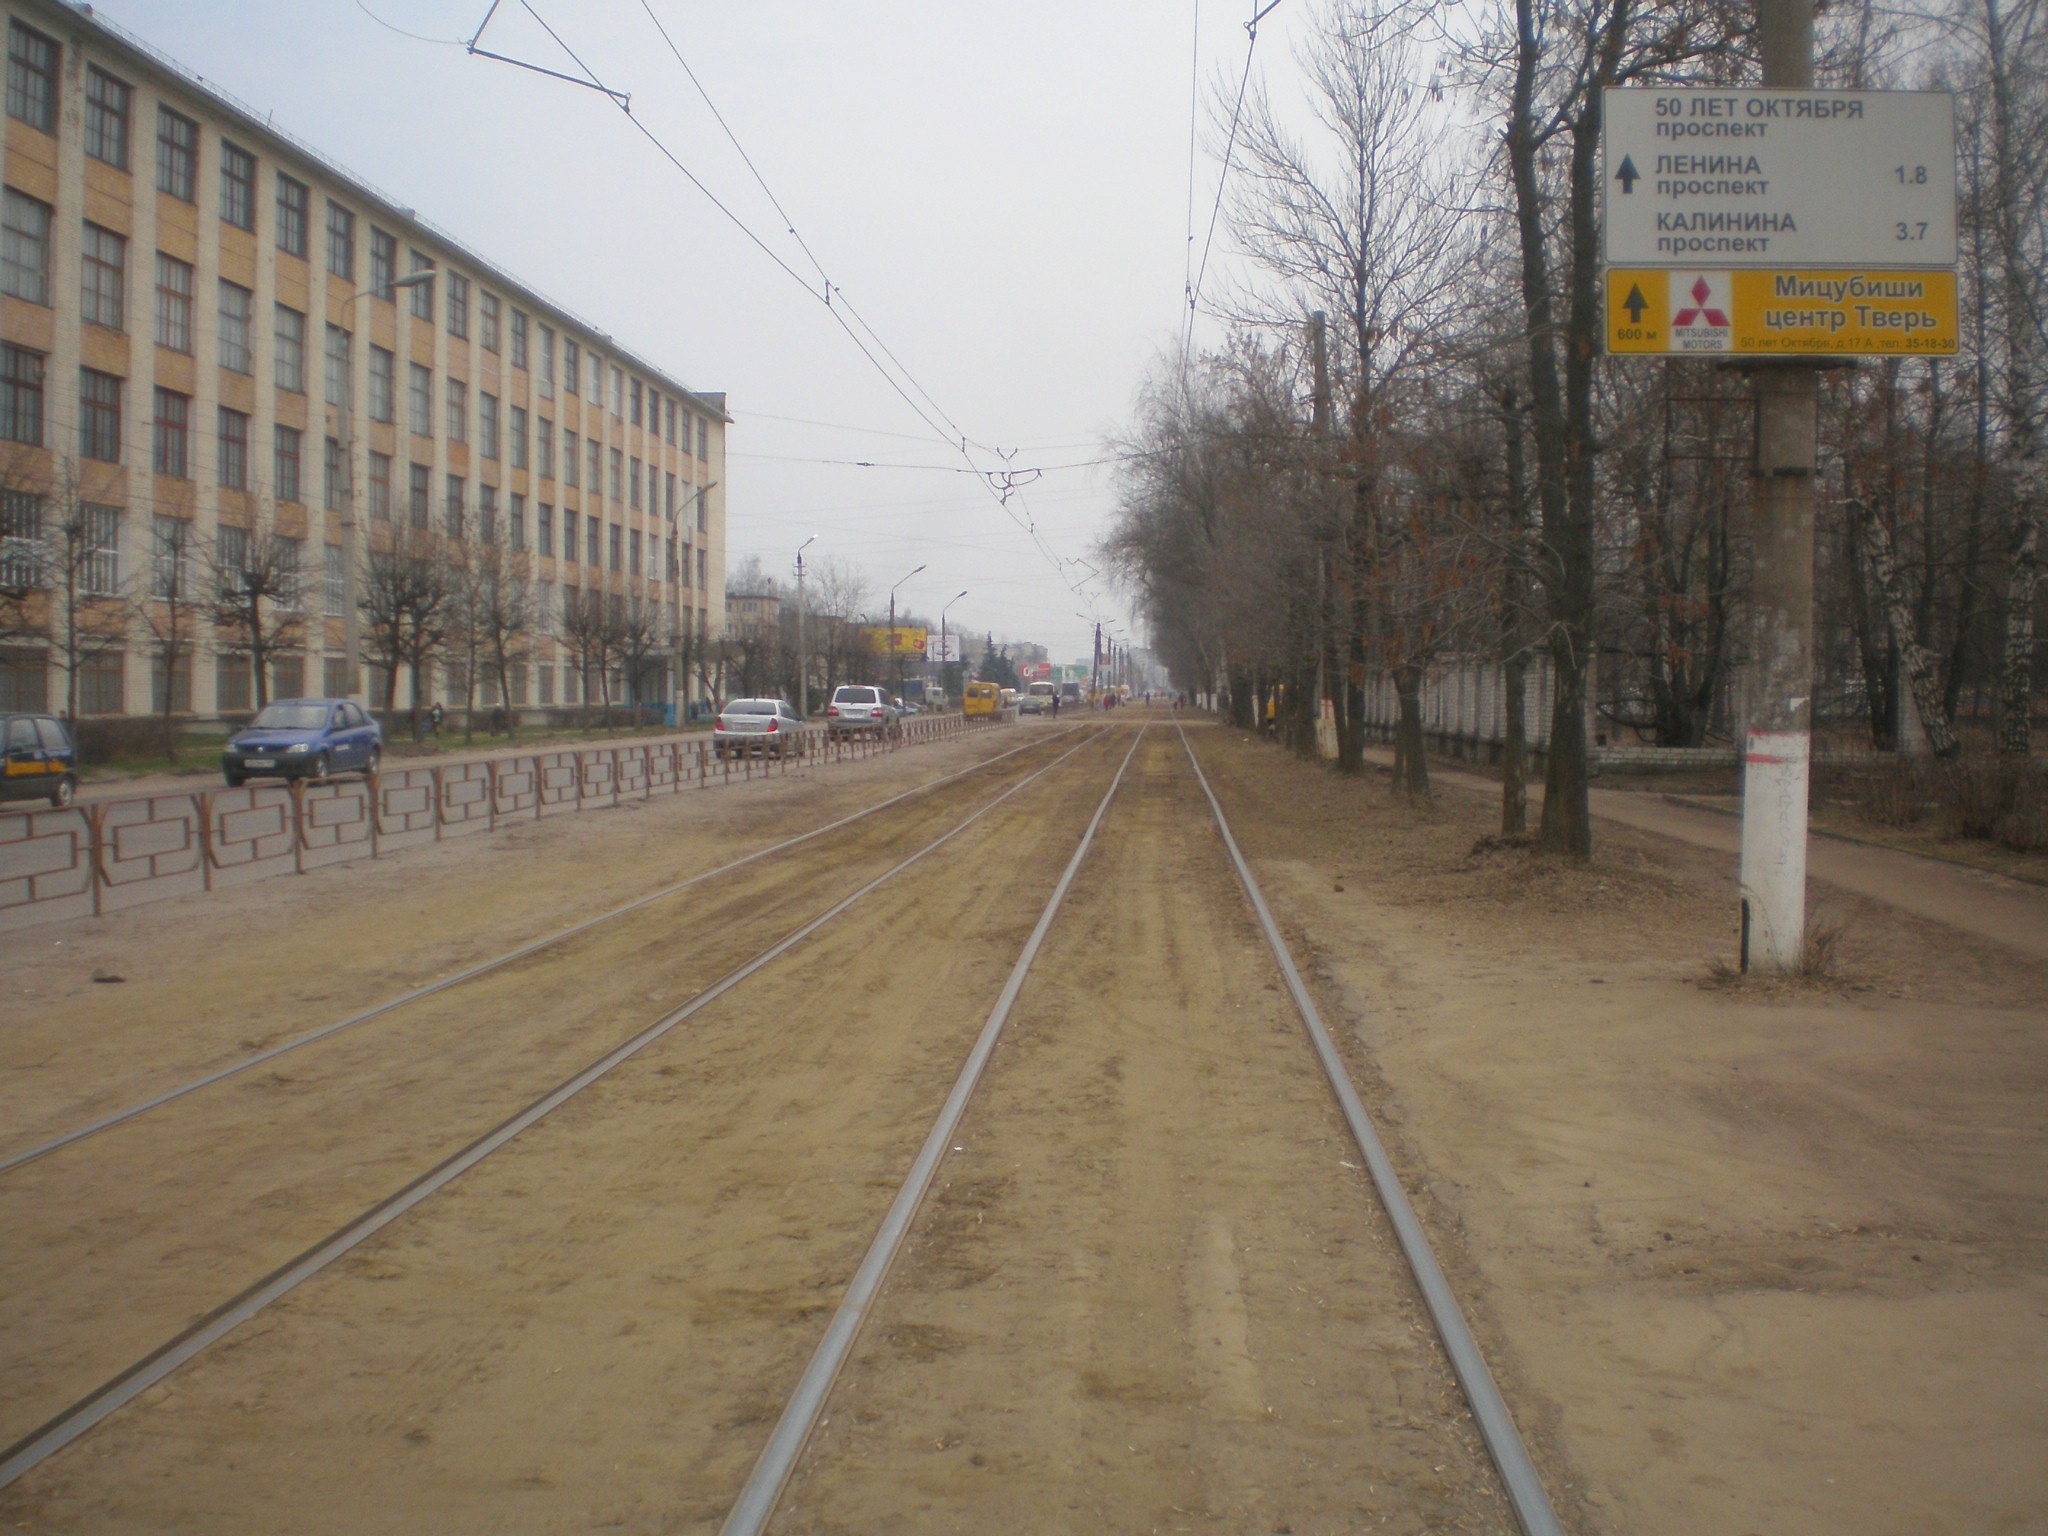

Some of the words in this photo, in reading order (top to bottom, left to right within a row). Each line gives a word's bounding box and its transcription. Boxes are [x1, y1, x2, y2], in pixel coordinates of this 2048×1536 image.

[1655, 98, 1681, 117] 50
[1690, 99, 1738, 117] ЛЕТ
[1746, 99, 1863, 119] ОКТЯБРЯ
[1656, 122, 1768, 139] проспект
[1656, 156, 1761, 174] ЛЕНИНА
[1896, 166, 1928, 184] 1.8
[1658, 179, 1770, 198] проспект
[1658, 213, 1796, 232] КАЛИНИНА
[1896, 223, 1928, 241] 3.7
[1658, 236, 1770, 255] проспект
[1776, 276, 1922, 301] Мицубиши
[1766, 310, 1846, 332] центр
[1855, 306, 1937, 332] Тверь
[1617, 329, 1642, 339] 600
[1675, 328, 1728, 337] MITSUBISHI
[1683, 340, 1722, 349] MOTORS
[1741, 337, 1754, 347] 50
[1758, 338, 1776, 347] лет
[1849, 338, 1860, 346] 17
[1905, 339, 1955, 348] 35-18-30
